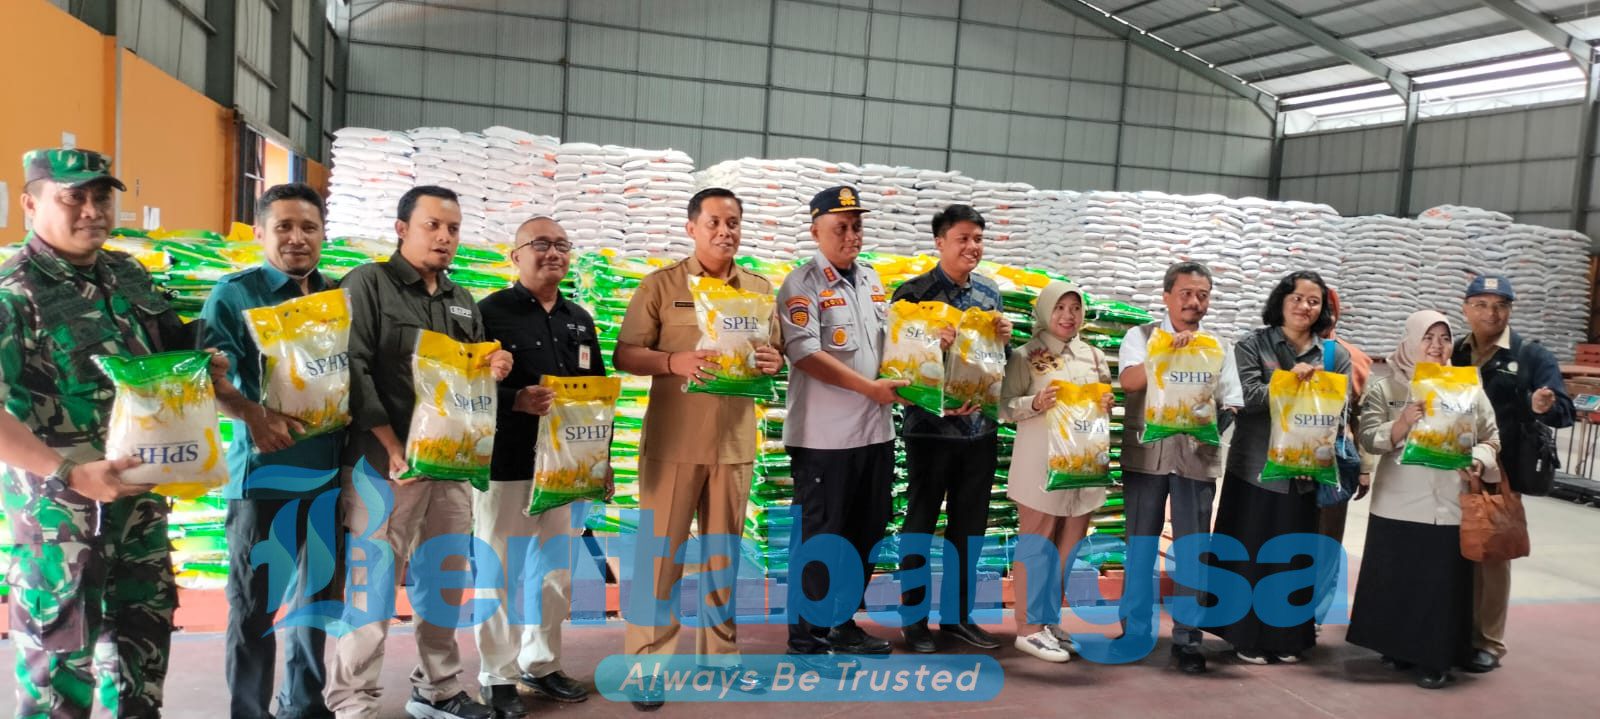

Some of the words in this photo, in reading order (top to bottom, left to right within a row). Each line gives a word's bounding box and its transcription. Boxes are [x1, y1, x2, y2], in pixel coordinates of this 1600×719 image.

[306, 352, 350, 376] SPHP
[1169, 371, 1212, 383] SPHP
[1294, 414, 1335, 426] SPHP
[565, 425, 609, 440] SPHP
